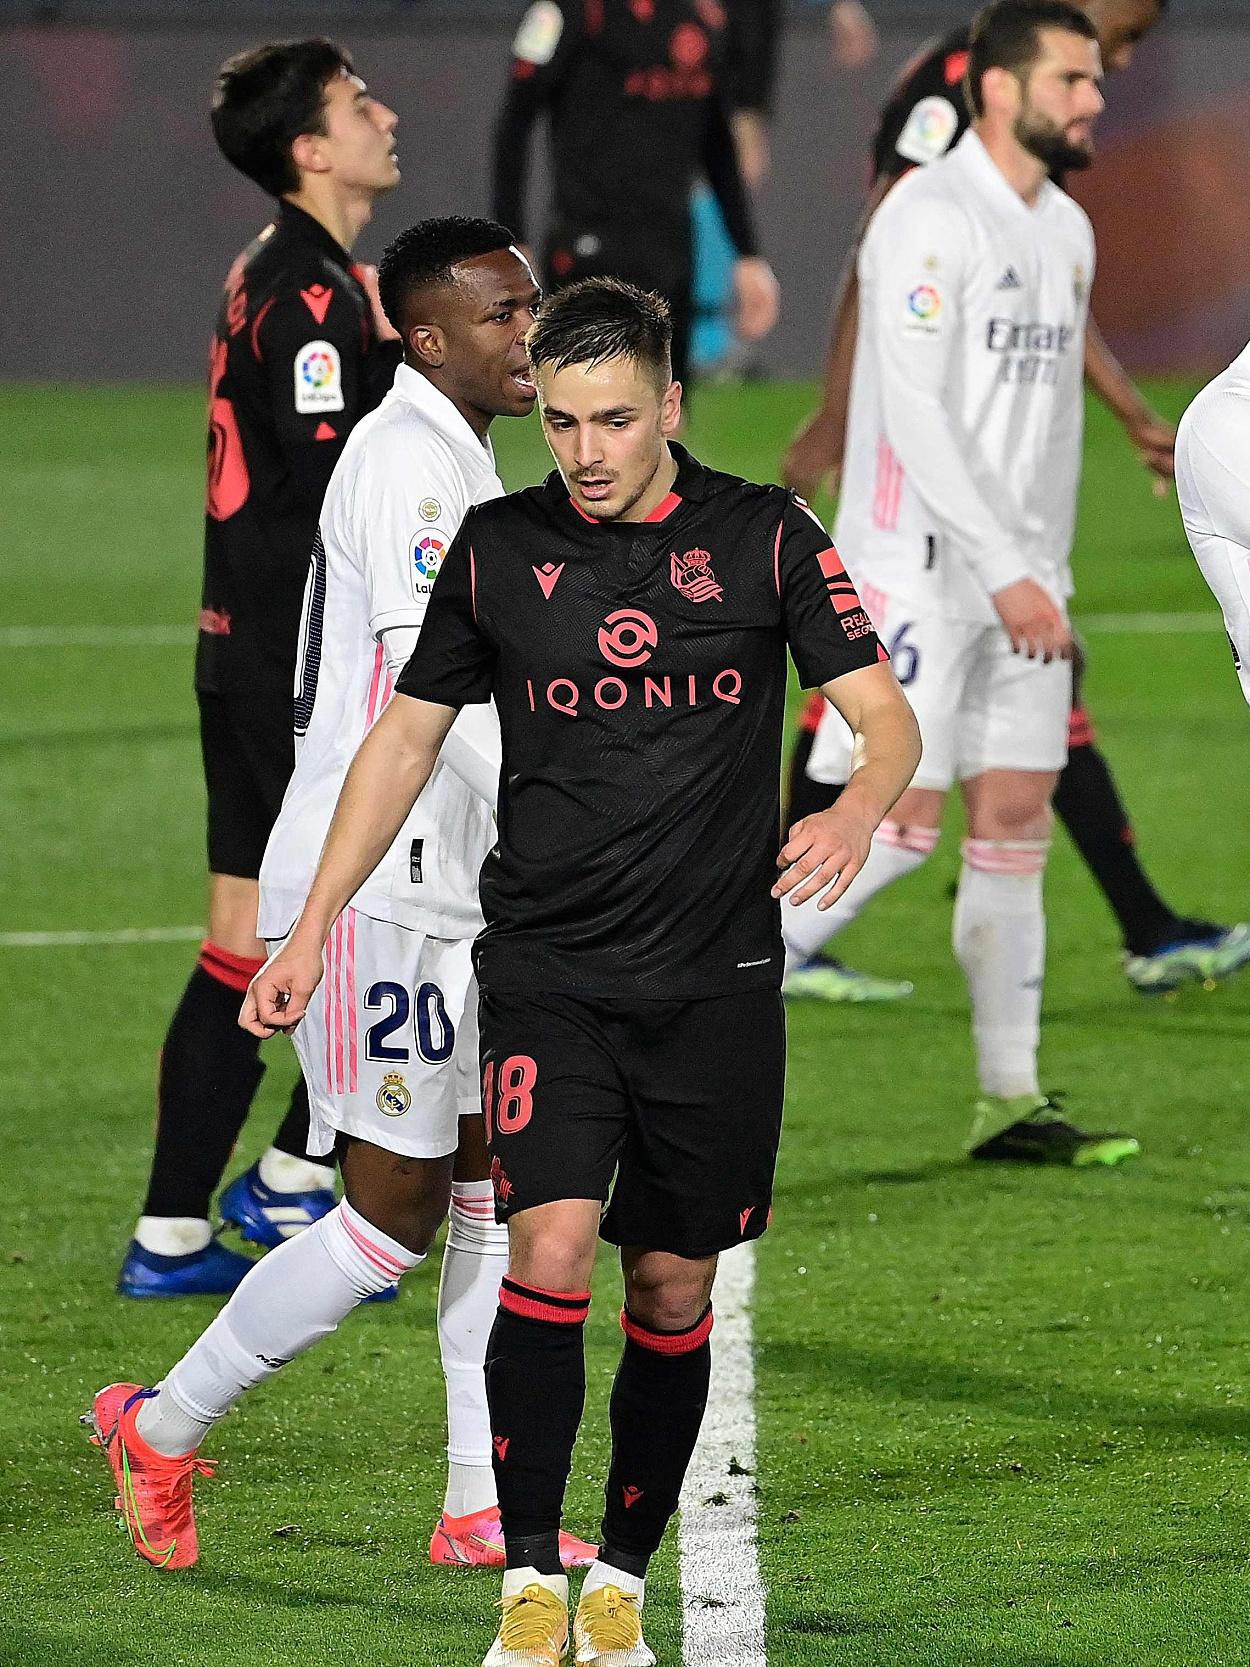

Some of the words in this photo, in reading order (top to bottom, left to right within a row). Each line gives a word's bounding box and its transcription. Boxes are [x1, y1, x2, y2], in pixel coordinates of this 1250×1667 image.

[527, 668, 742, 717] IQONIQ
[364, 981, 455, 1065] 20
[481, 1055, 538, 1147] 18
